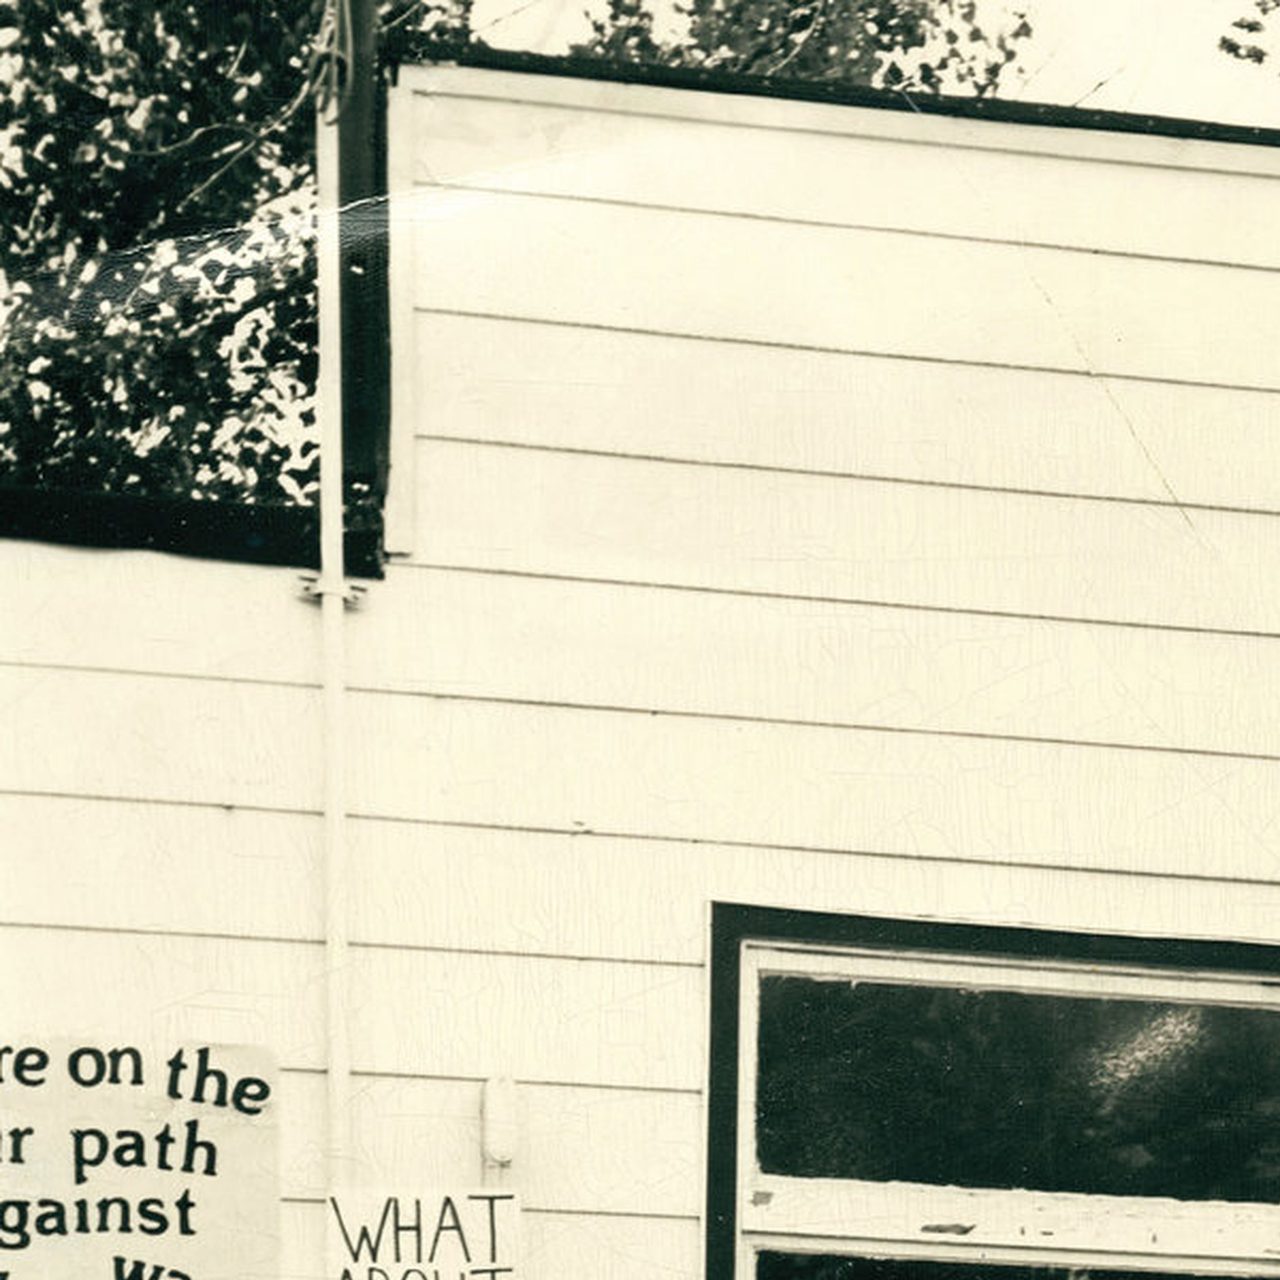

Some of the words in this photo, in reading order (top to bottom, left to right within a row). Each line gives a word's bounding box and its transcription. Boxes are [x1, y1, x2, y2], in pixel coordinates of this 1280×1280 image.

[68, 1046, 144, 1087] on
[167, 1047, 271, 1115] the
[71, 1120, 218, 1184] path
[0, 1189, 196, 1250] gainst
[330, 1195, 514, 1263] WHAT
